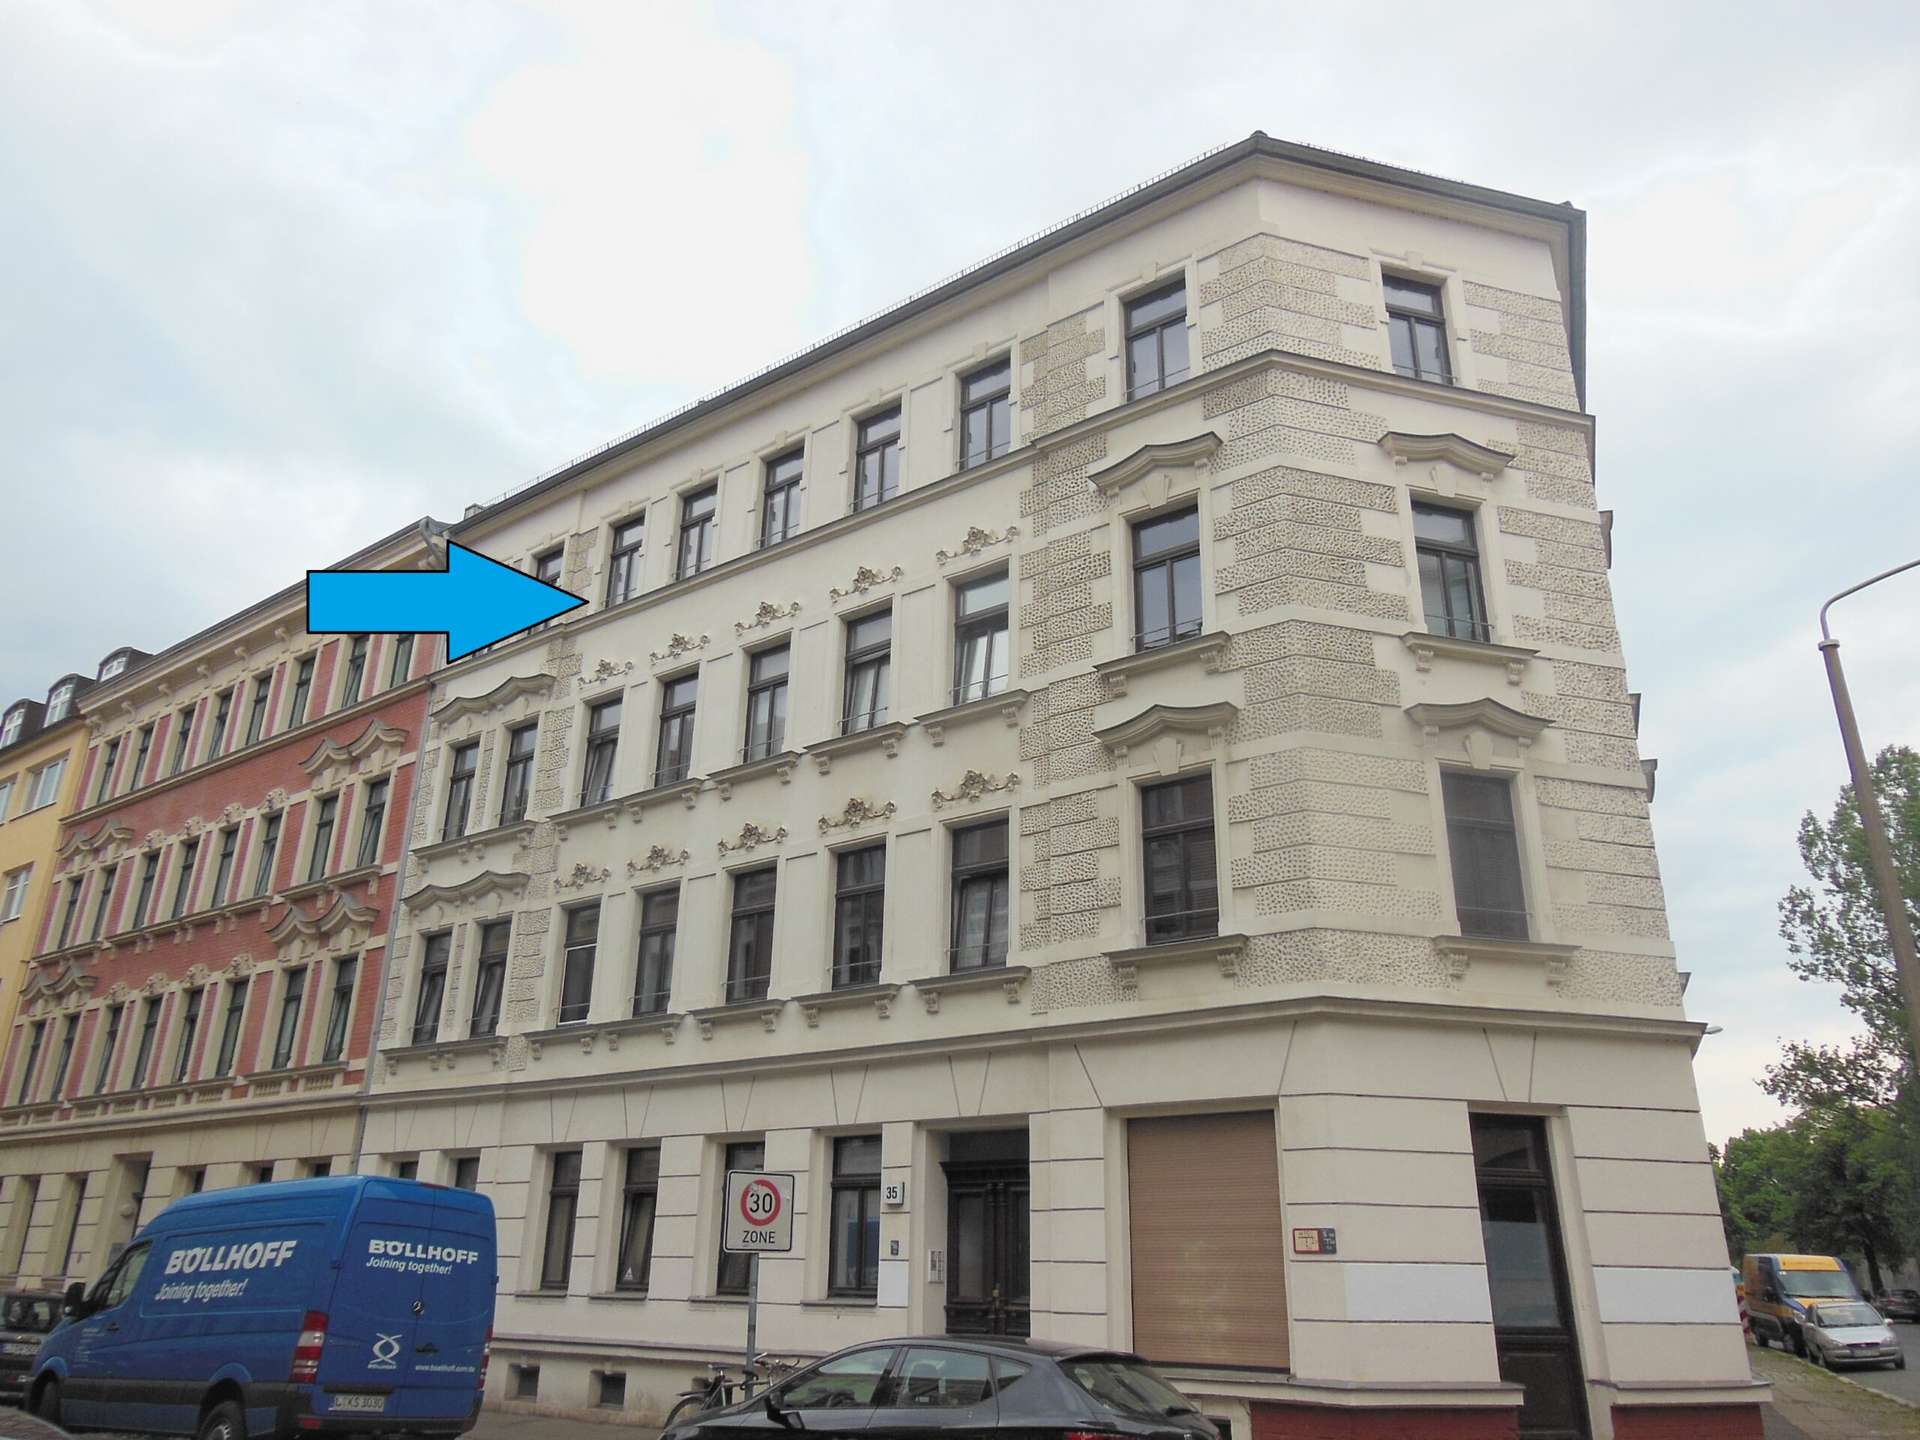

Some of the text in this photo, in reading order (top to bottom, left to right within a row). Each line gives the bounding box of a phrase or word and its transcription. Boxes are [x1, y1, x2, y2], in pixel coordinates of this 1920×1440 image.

[886, 1186, 898, 1199] 35
[749, 1193, 773, 1213] 30
[742, 1230, 776, 1244] ZONE
[368, 1239, 479, 1264] BÖLLHOFF
[366, 1256, 452, 1274] Joining together!
[155, 1278, 249, 1303] Joining together!
